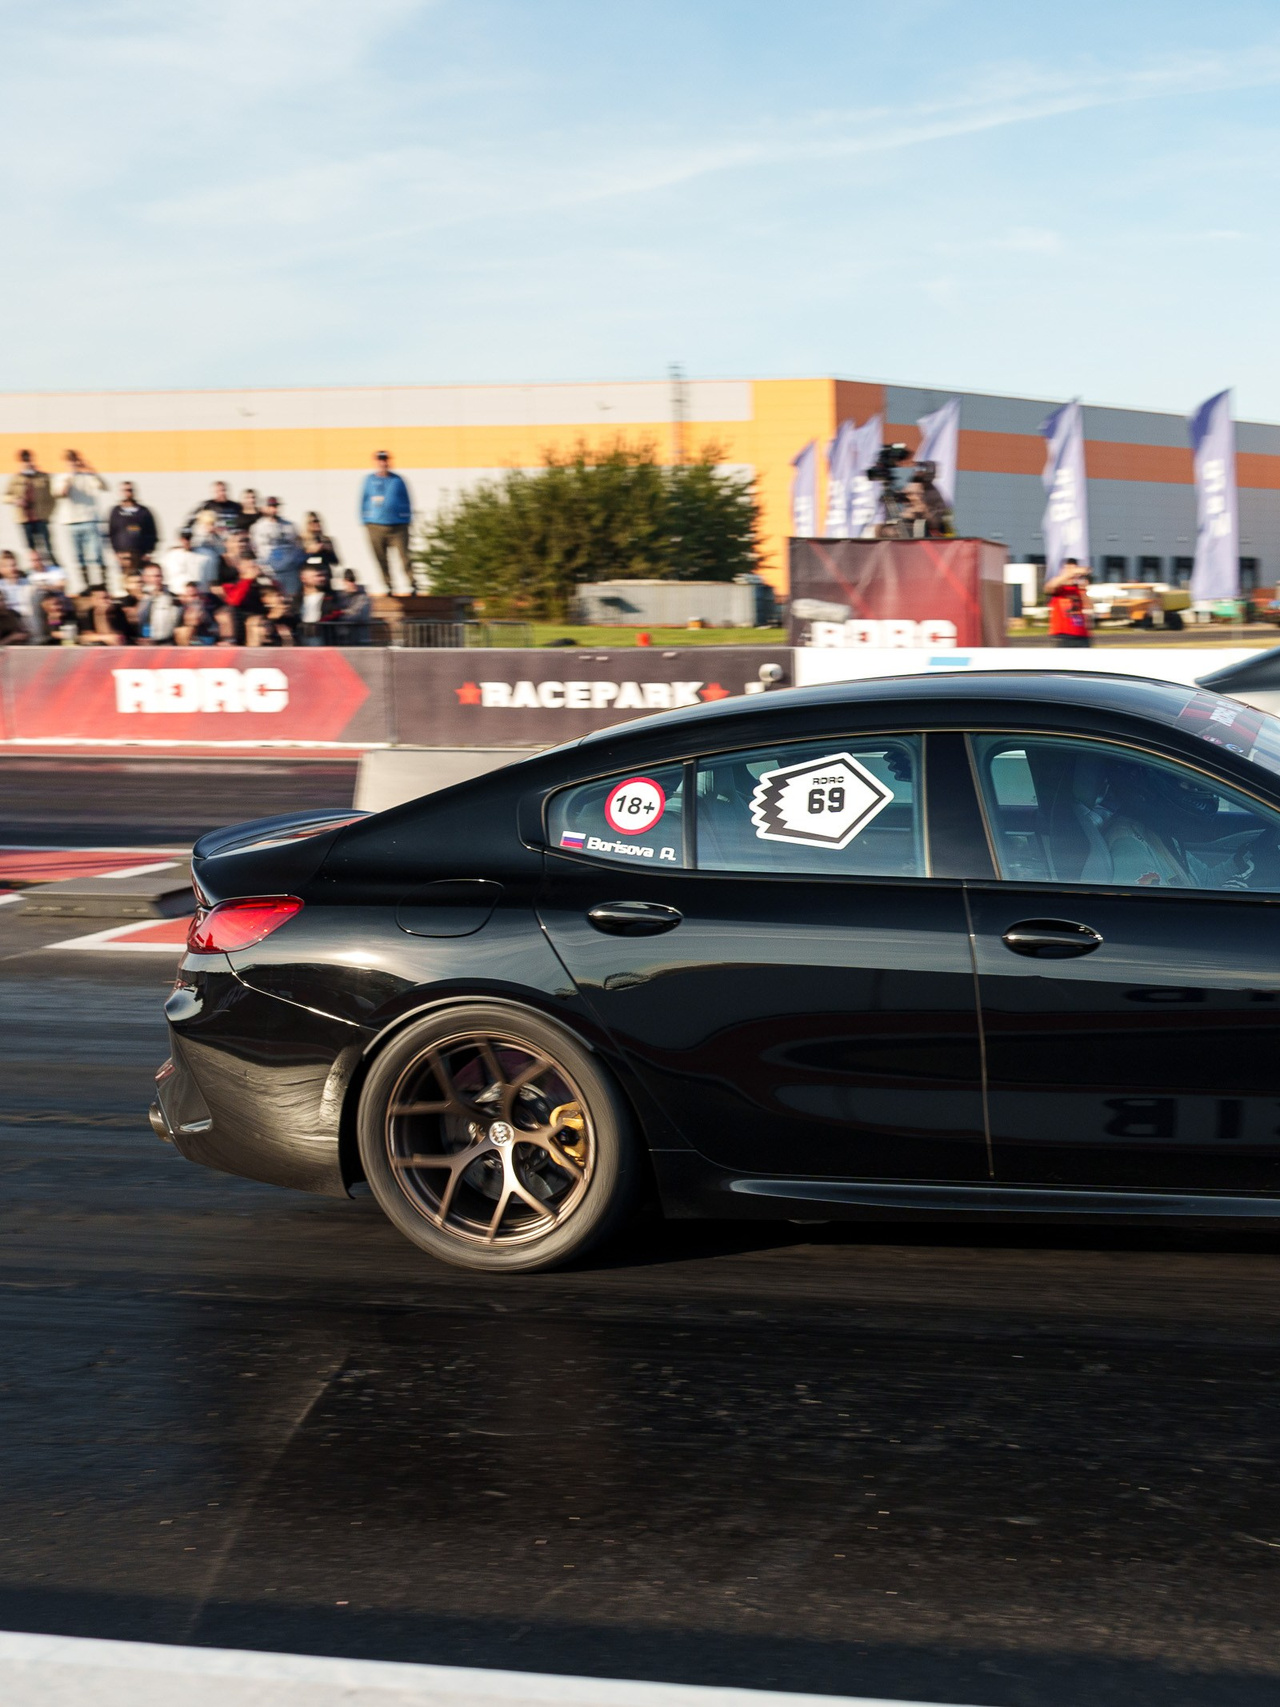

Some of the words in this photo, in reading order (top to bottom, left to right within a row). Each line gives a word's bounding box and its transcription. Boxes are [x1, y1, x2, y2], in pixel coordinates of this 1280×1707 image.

[480, 682, 703, 708] RACEPARK
[616, 795, 655, 815] 18+
[808, 787, 845, 814] 69
[587, 837, 654, 858] Borisova
